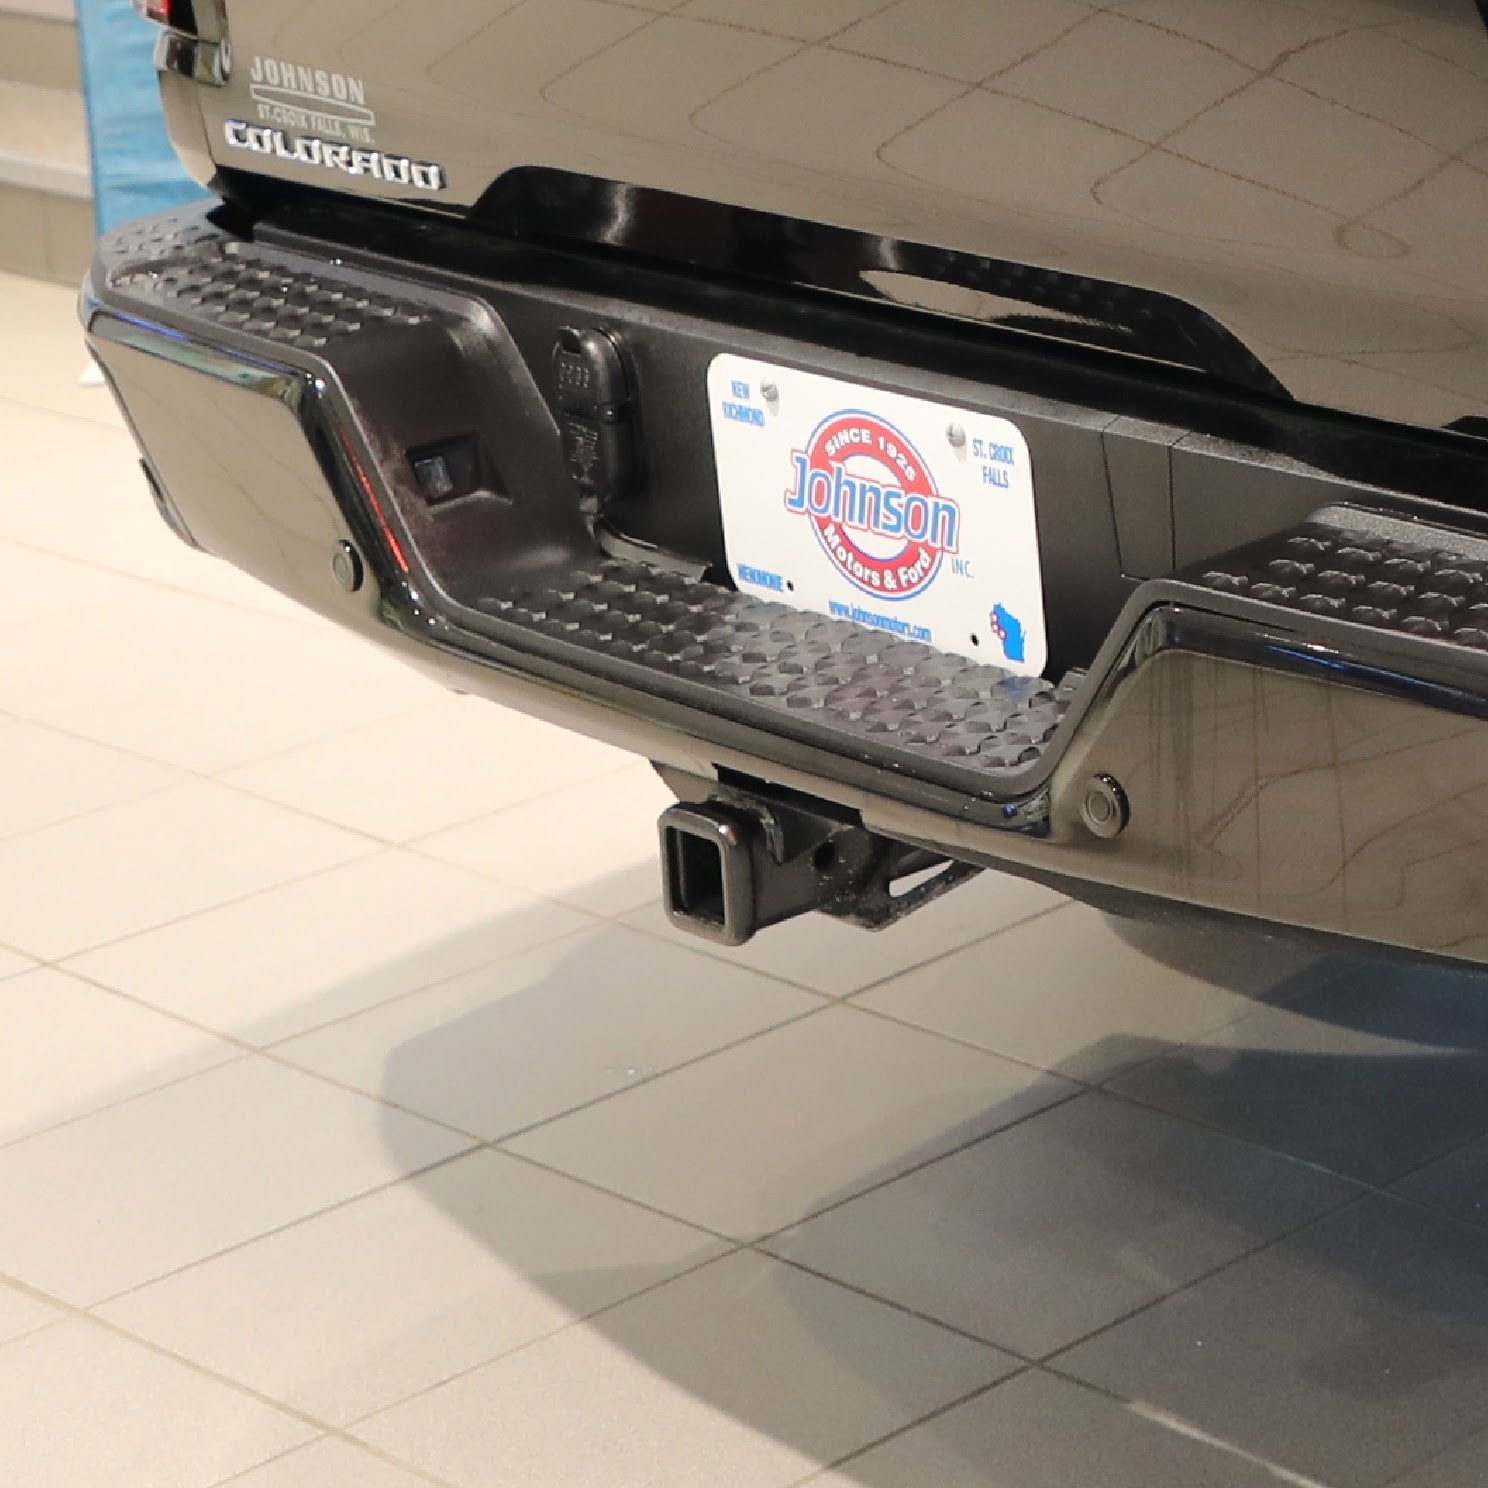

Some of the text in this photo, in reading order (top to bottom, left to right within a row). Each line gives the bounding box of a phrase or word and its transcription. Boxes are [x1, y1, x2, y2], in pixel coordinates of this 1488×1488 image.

[250, 56, 367, 104] JOHNSON
[224, 118, 446, 191] COLORADO
[824, 428, 872, 457] SINCE
[787, 454, 957, 549] Johnson
[824, 522, 931, 590] Motors & Ford
